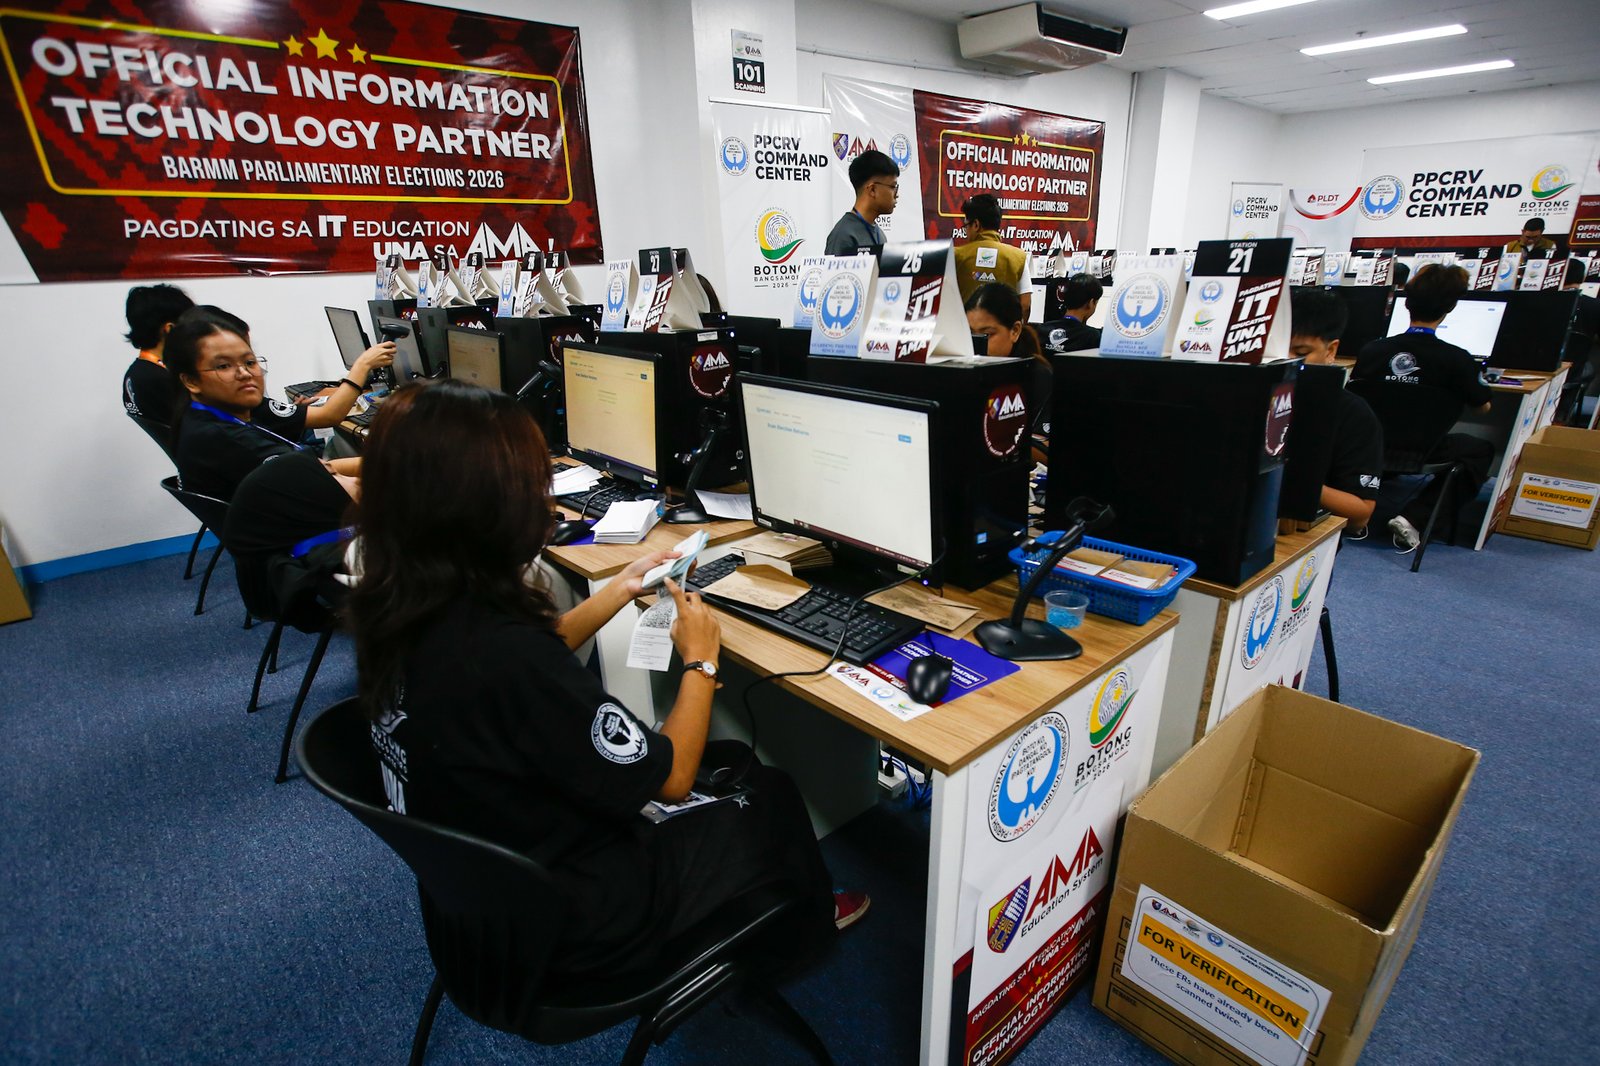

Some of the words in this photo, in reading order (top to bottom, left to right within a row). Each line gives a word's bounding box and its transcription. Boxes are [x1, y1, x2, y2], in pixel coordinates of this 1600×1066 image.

[31, 38, 278, 96] OFFICIAL
[288, 65, 550, 119] INFORMATION
[736, 61, 762, 84] 101
[735, 82, 765, 94] SCANNING
[52, 96, 380, 150] TECHNOLOGY
[396, 123, 552, 161] PARTNER
[754, 134, 801, 151] PPCRV
[754, 151, 829, 168] COMMAND
[946, 141, 1009, 165] OFFICIAL
[1011, 149, 1090, 174] INFORMATION
[164, 154, 239, 181] BARMM
[243, 160, 381, 187] PARLIAMENTARY
[387, 166, 465, 190] ELECTIONS
[468, 169, 505, 191] 2026
[755, 166, 811, 182] CENTER
[946, 169, 1036, 192] TECHNOLOGY
[1037, 178, 1088, 196] PARTNER
[1412, 168, 1484, 188] PPCRV
[1246, 196, 1269, 204] PPCRV
[1317, 194, 1340, 203] PLDT
[1408, 184, 1523, 202] COMMAND
[1520, 200, 1570, 209] BOTONG
[1245, 204, 1279, 212] COMMAND
[1405, 202, 1489, 218] CENTER
[124, 218, 276, 240] PAGDATING
[281, 219, 313, 240] SA
[319, 215, 347, 238] IT
[353, 220, 470, 238] EDUCATION
[1006, 226, 1016, 239] IT
[1017, 228, 1054, 240] EDUCATION
[373, 241, 430, 261] UNA
[434, 243, 459, 260] SA
[465, 221, 542, 260] AMA
[1020, 240, 1038, 252] UNA
[1050, 231, 1075, 251] AMA
[609, 261, 630, 271] PPCRV
[650, 254, 660, 273] 27
[803, 258, 826, 266] PPCR
[828, 259, 868, 270] PPCRV
[901, 250, 923, 274] 26
[1227, 247, 1255, 274] 21
[1239, 278, 1283, 298] PAGDATING
[910, 285, 941, 321] IT
[1238, 286, 1281, 322] IT
[1226, 322, 1267, 345] UNA
[1229, 314, 1273, 331] EDUCATION
[872, 340, 890, 351] AMA
[898, 340, 927, 359] AMA
[1189, 342, 1212, 353] AMA
[1223, 337, 1263, 360] AMA
[703, 351, 730, 368] AMA
[998, 393, 1025, 416] AMA
[1523, 488, 1538, 497] FOR
[1540, 491, 1591, 505] VERIFICATION
[846, 671, 870, 687] AMA
[1074, 739, 1132, 788] BANGSAMORO
[1076, 726, 1133, 778] BOTONG
[989, 764, 1009, 820] PASTORAL
[1023, 825, 1104, 925] AMA
[1020, 888, 1071, 938] Education
[1072, 857, 1104, 892] System
[1070, 906, 1096, 941] AMA
[972, 979, 1018, 1025] PAGDATING
[1017, 968, 1028, 984] SA
[1027, 955, 1039, 973] IT
[1037, 923, 1077, 964] EDUCATION
[1046, 952, 1089, 1003] PARTNER
[1142, 925, 1176, 953] FOR
[1179, 945, 1301, 1029] VERIFICATION
[1287, 975, 1310, 994] CENTER
[972, 1010, 1024, 1064] OFFICIAL
[1025, 940, 1092, 1014] INFORMATION
[1149, 954, 1175, 976] These
[1176, 969, 1192, 987] ERs
[1193, 978, 1216, 999] have
[1217, 991, 1253, 1024] already
[1254, 1018, 1280, 1040] been
[1176, 982, 1213, 1010] scanned
[1214, 1002, 1243, 1029] twice.
